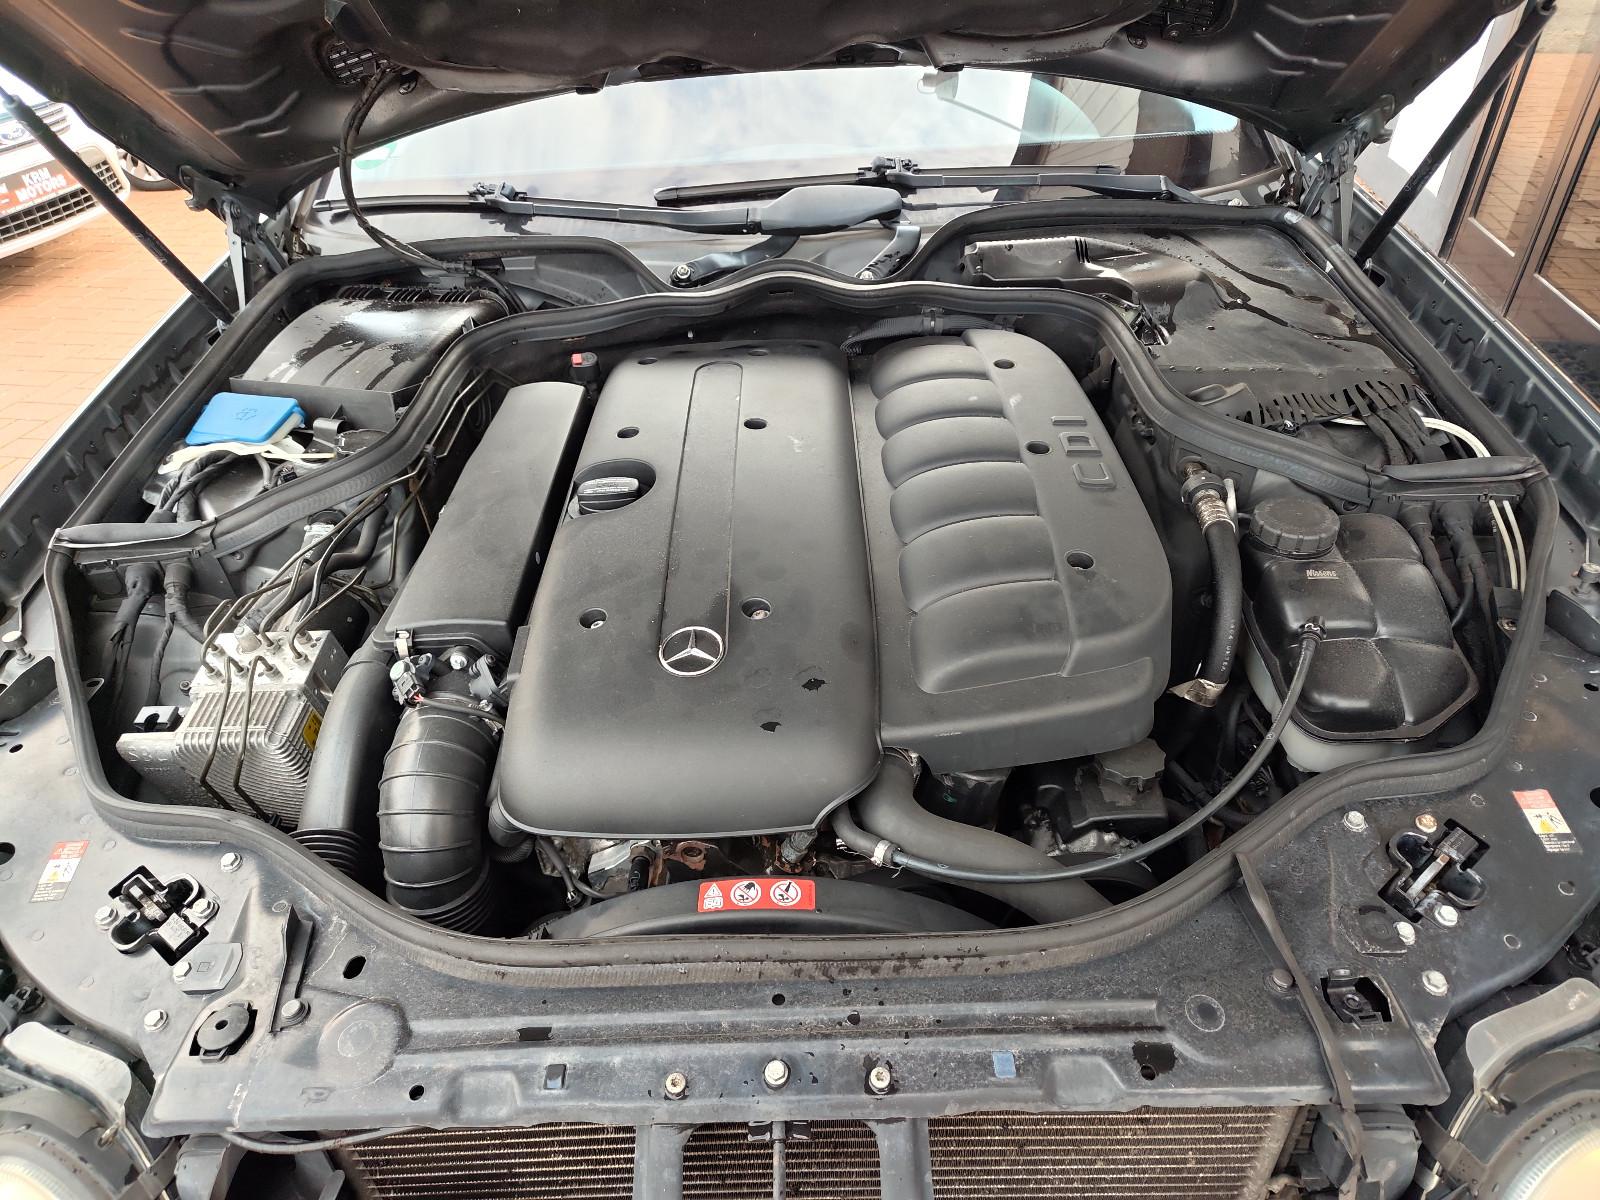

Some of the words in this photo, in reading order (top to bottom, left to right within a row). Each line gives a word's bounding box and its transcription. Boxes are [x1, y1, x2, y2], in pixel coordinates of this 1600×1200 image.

[15, 174, 67, 202] MOTORS
[21, 167, 52, 187] KRM
[1051, 415, 1117, 490] CDI
